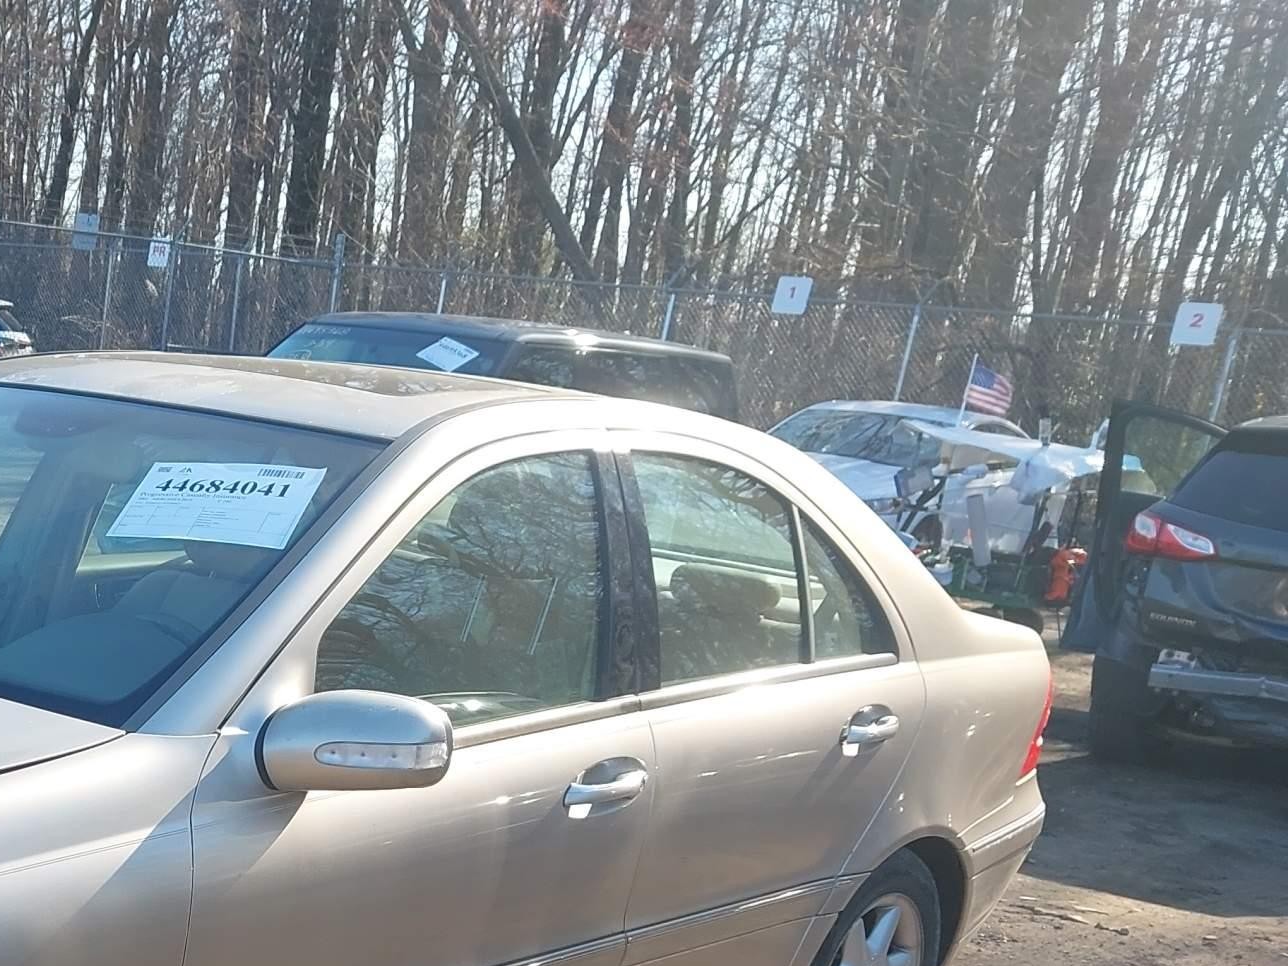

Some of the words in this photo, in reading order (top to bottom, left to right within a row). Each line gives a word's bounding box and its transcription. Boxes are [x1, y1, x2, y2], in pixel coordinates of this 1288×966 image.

[789, 286, 797, 299] 1
[1189, 312, 1205, 328] 2
[155, 477, 292, 499] 44684041
